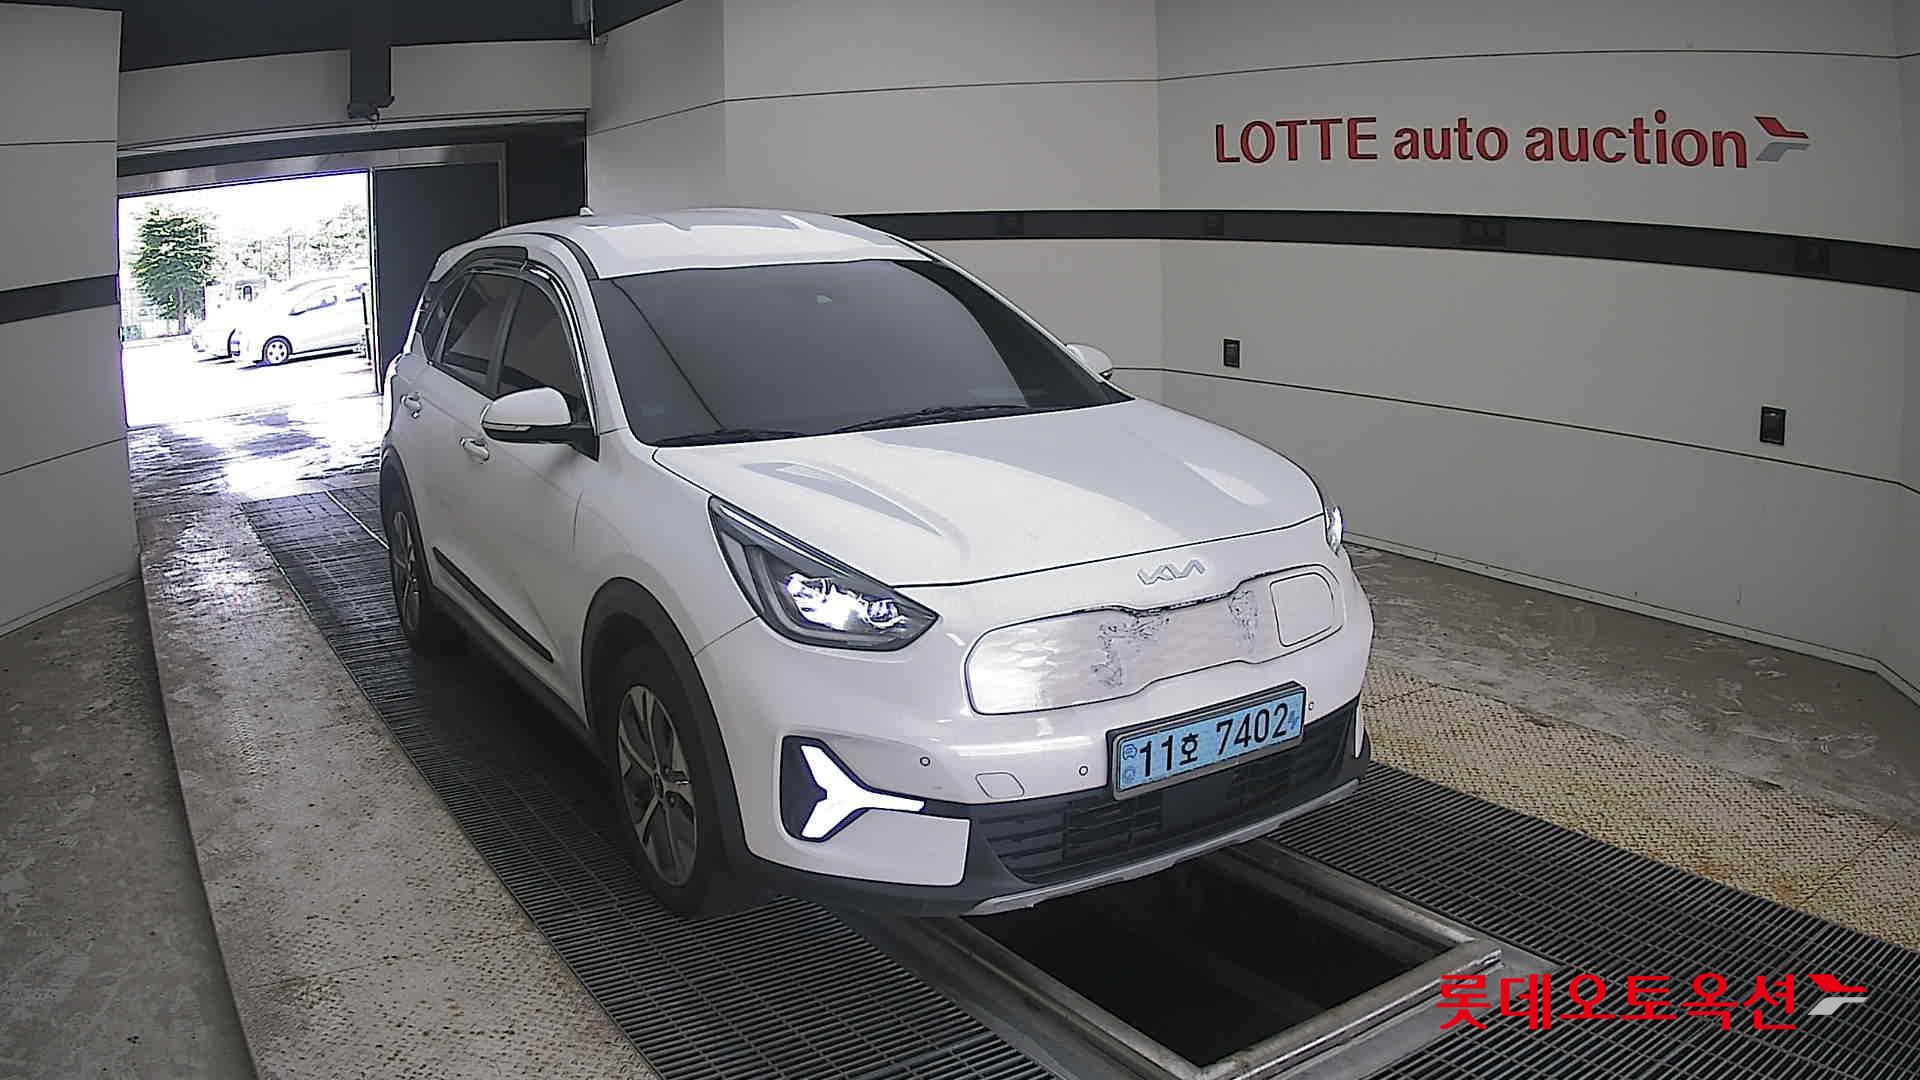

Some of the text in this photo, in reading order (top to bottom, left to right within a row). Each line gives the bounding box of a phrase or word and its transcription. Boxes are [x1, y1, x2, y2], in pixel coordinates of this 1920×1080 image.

[1215, 110, 1748, 168] LOTTE auto auction
[1139, 703, 1289, 777] 11호 7402
